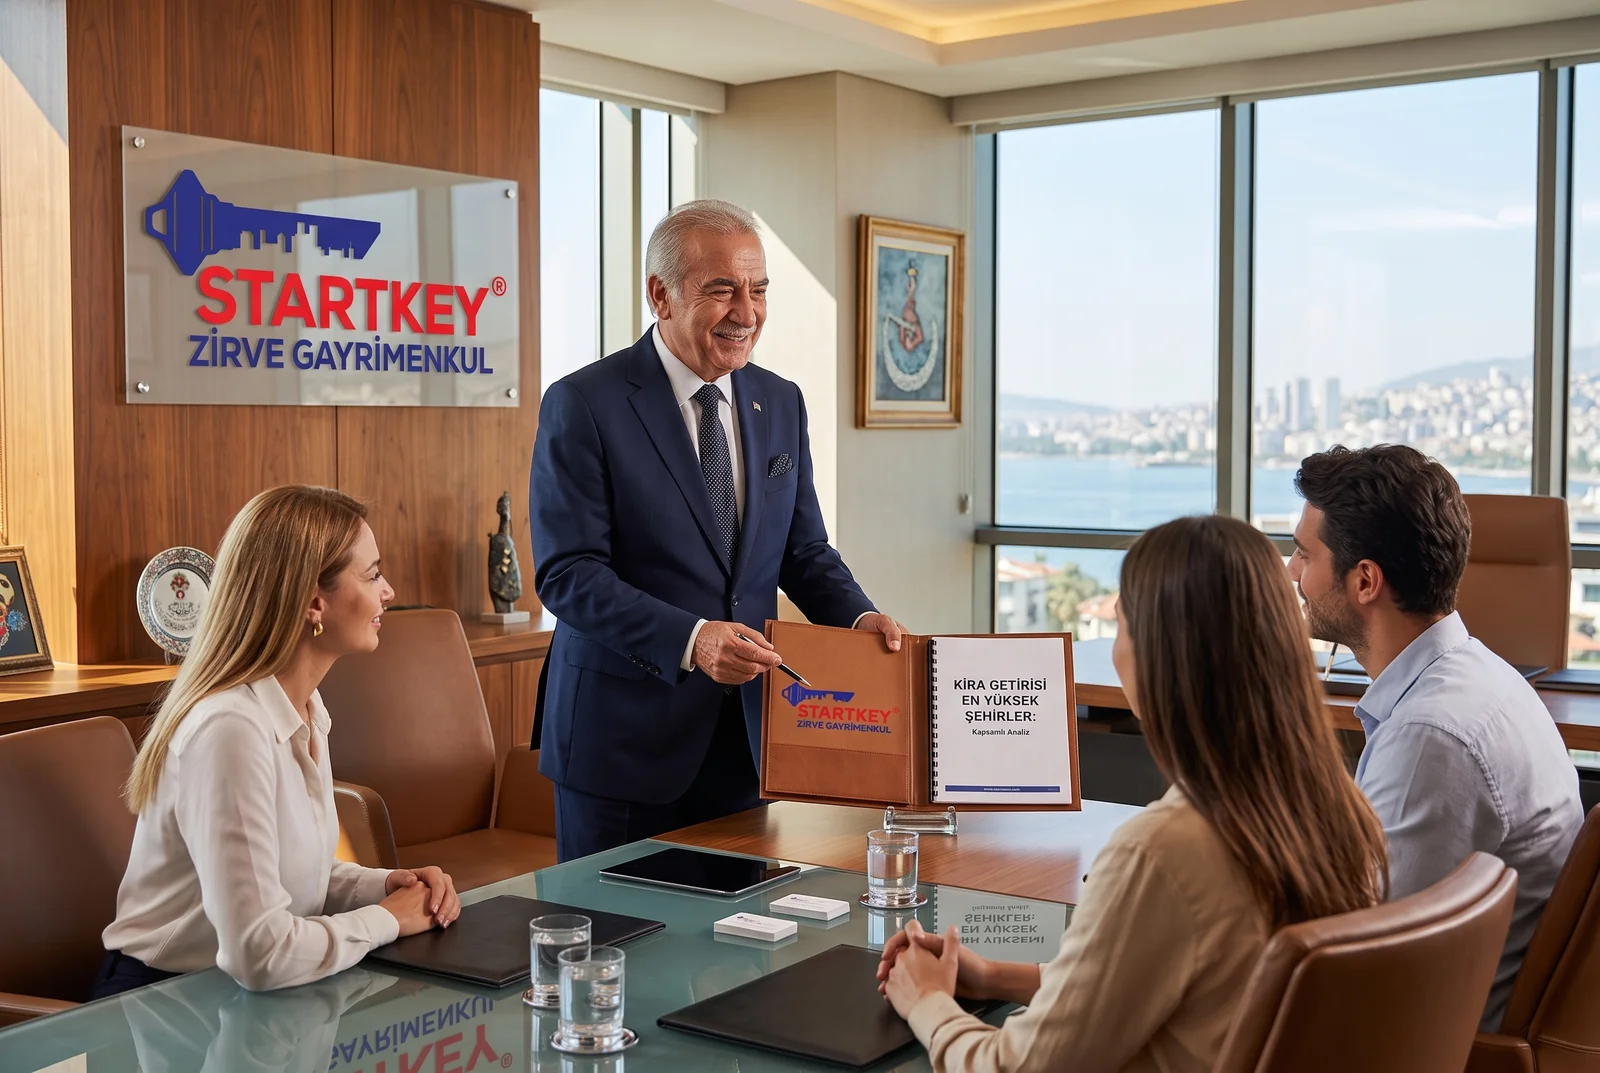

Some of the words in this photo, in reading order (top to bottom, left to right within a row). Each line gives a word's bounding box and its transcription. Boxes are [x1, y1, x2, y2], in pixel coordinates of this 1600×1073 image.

[188, 327, 284, 369] ZİRVE
[292, 335, 494, 375] GAYRİMENKUL
[953, 678, 986, 691] KİRA
[989, 678, 1047, 691] GETİRİSİ
[962, 695, 980, 706] EN
[984, 693, 1039, 706] YÜKSEK
[965, 708, 1037, 723] ŞEHİRLER:
[797, 719, 824, 729] ZİRVE
[826, 722, 892, 734] GAYRİMENKUL
[972, 728, 1006, 737] Kapsamlı
[1007, 728, 1030, 736] Analiz
